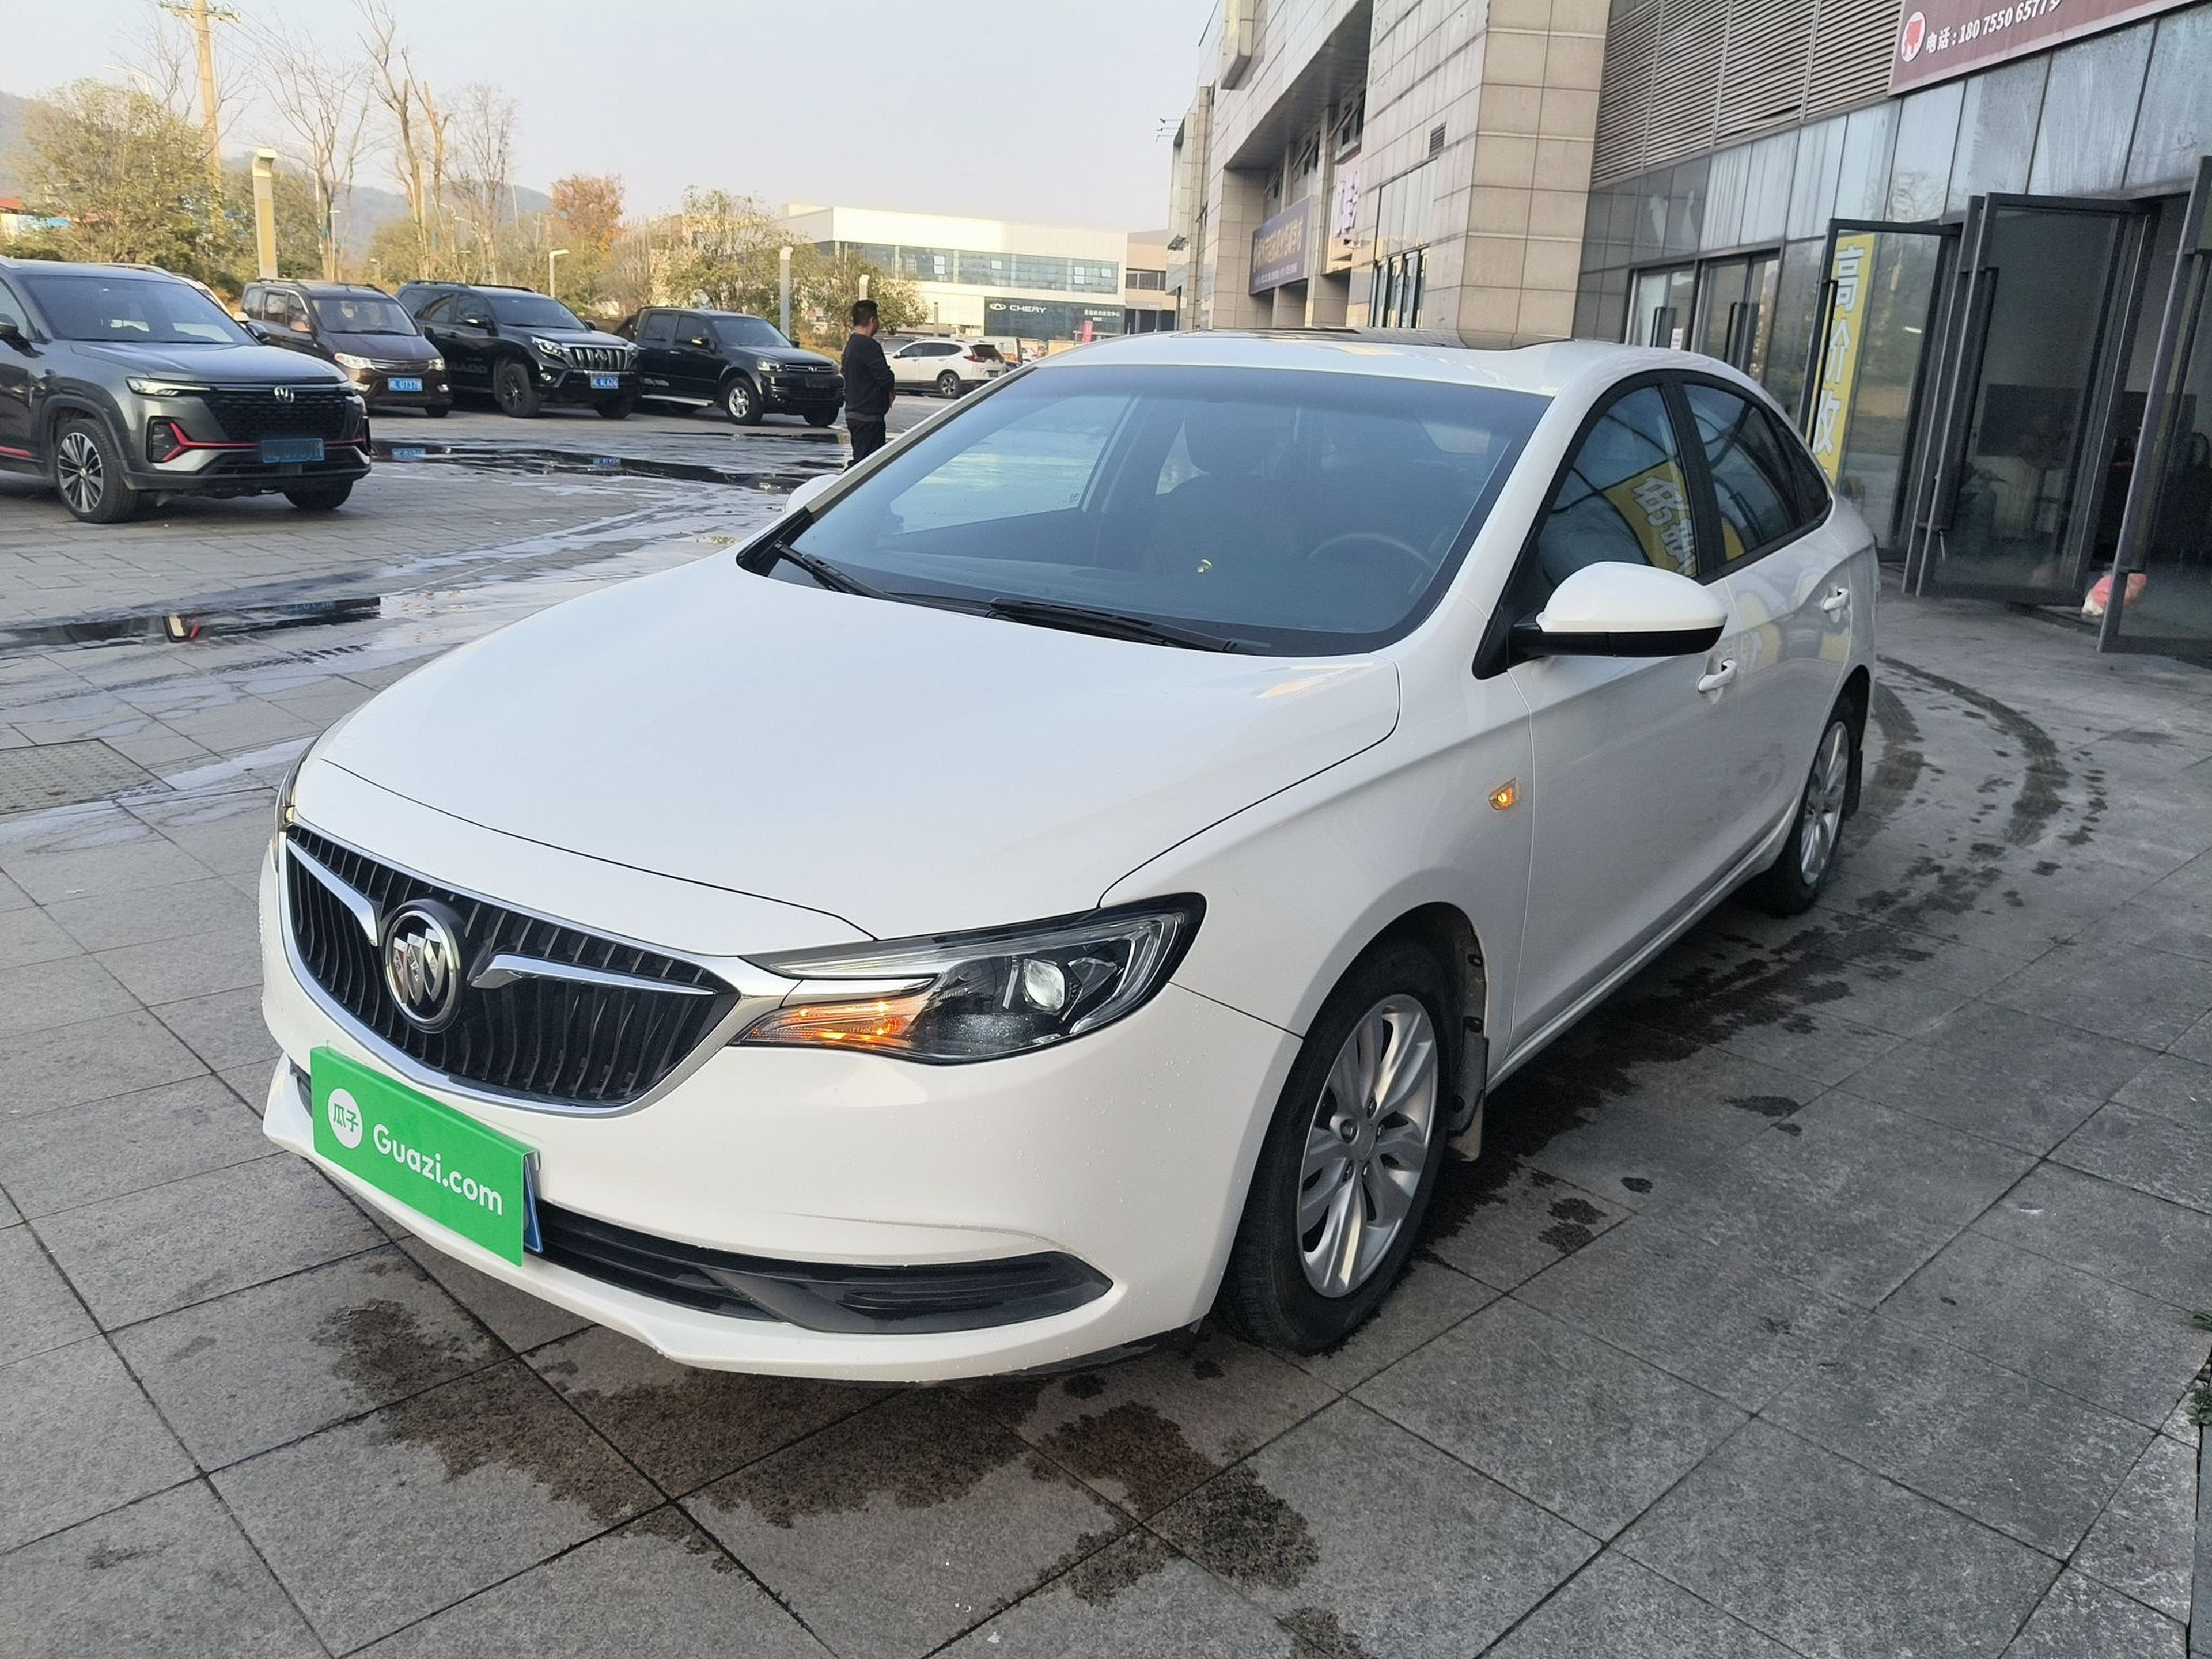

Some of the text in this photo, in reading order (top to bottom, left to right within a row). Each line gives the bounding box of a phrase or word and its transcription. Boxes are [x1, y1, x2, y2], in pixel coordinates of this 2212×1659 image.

[1982, 7, 2013, 35] 7550
[1009, 304, 1046, 313] CHERY
[1812, 244, 1865, 472] 高价收
[333, 1103, 359, 1132] 瓜子
[373, 1123, 503, 1216] Guazi.com
